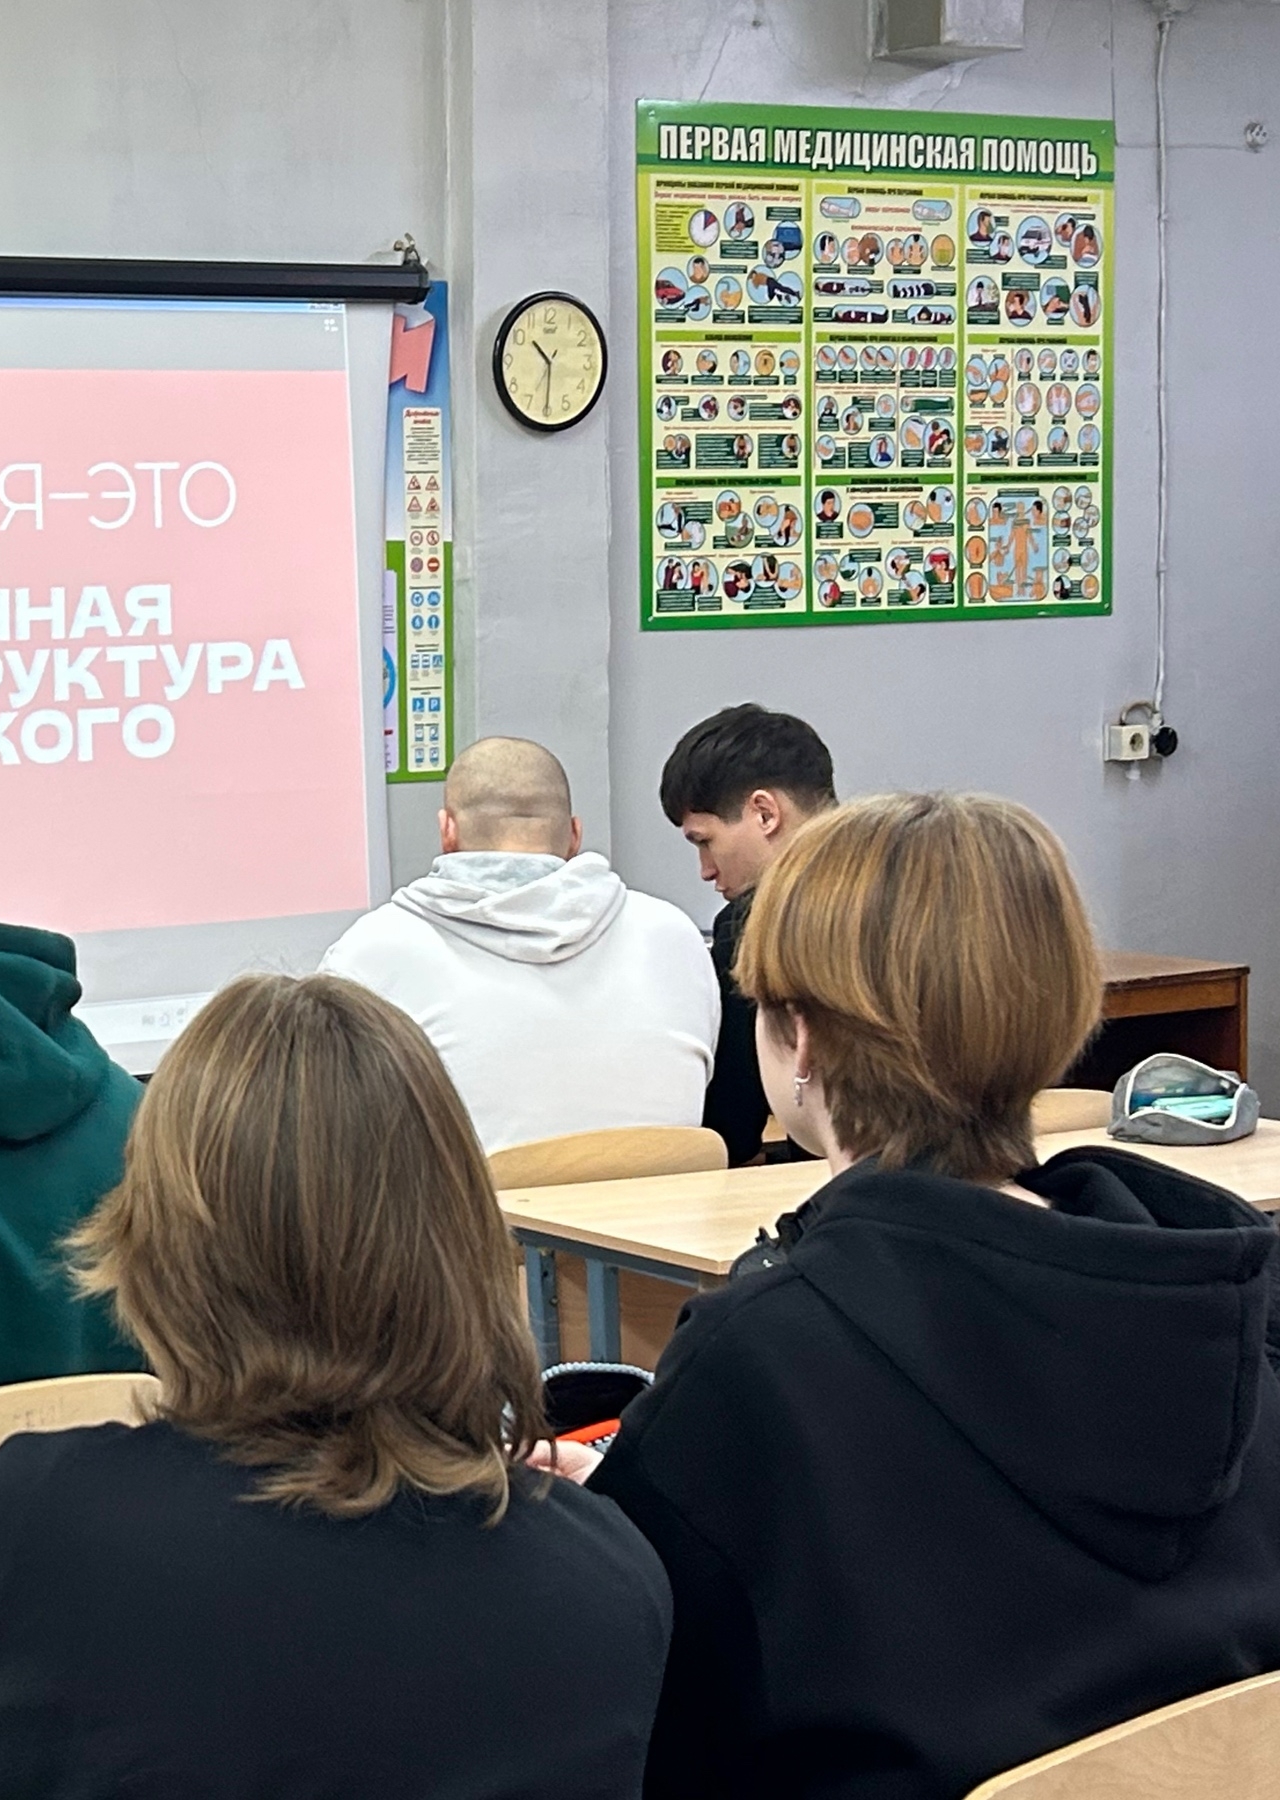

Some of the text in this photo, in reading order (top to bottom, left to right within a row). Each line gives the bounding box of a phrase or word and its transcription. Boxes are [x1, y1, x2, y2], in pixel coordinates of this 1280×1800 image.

[659, 124, 1099, 180] ПЕРВАЯ МЕДИЦИНСКАЯ ПОМОЩЬ
[527, 313, 535, 329] 11
[544, 307, 556, 324] 12
[513, 328, 525, 346] 10
[577, 330, 587, 347] 2
[503, 353, 513, 370] 9
[583, 354, 592, 371] 3
[509, 377, 518, 394] 8
[576, 378, 585, 394] 4
[524, 394, 533, 410] 7
[561, 394, 571, 411] 5
